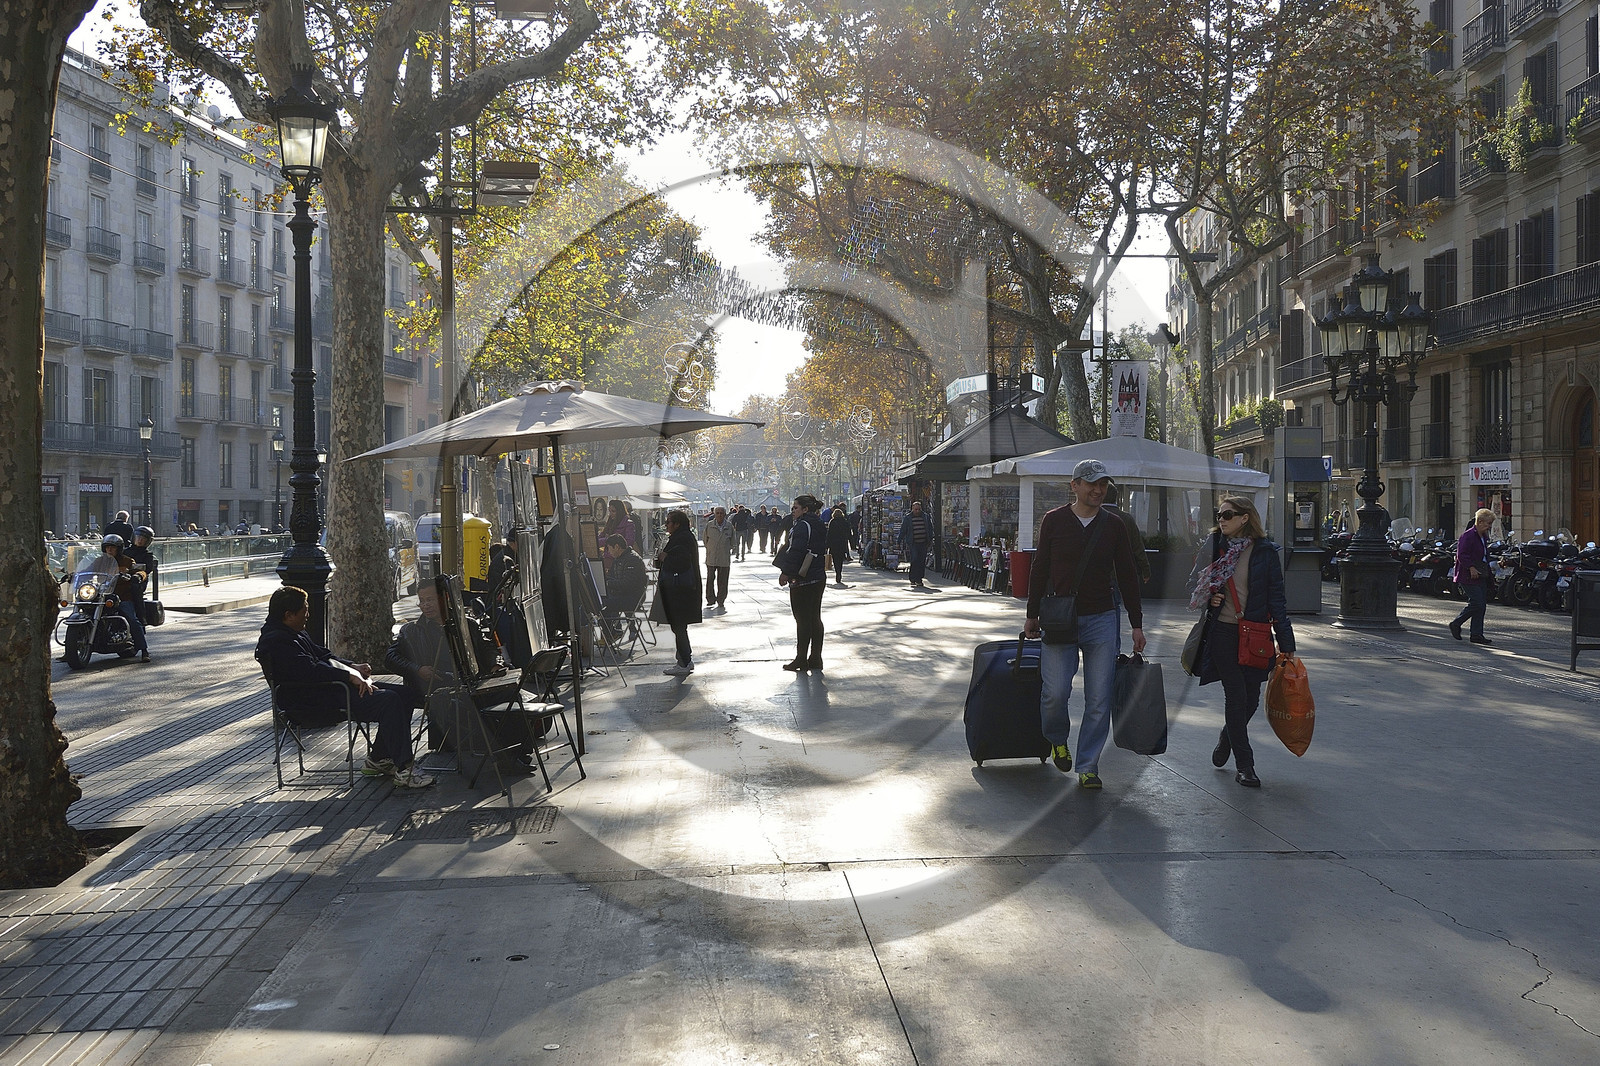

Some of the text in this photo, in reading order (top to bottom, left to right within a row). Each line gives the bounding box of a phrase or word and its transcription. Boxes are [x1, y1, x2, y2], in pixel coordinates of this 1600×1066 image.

[1471, 466, 1510, 480] I Barcelona
[99, 483, 113, 493] KING
[479, 535, 487, 579] ORREOS
